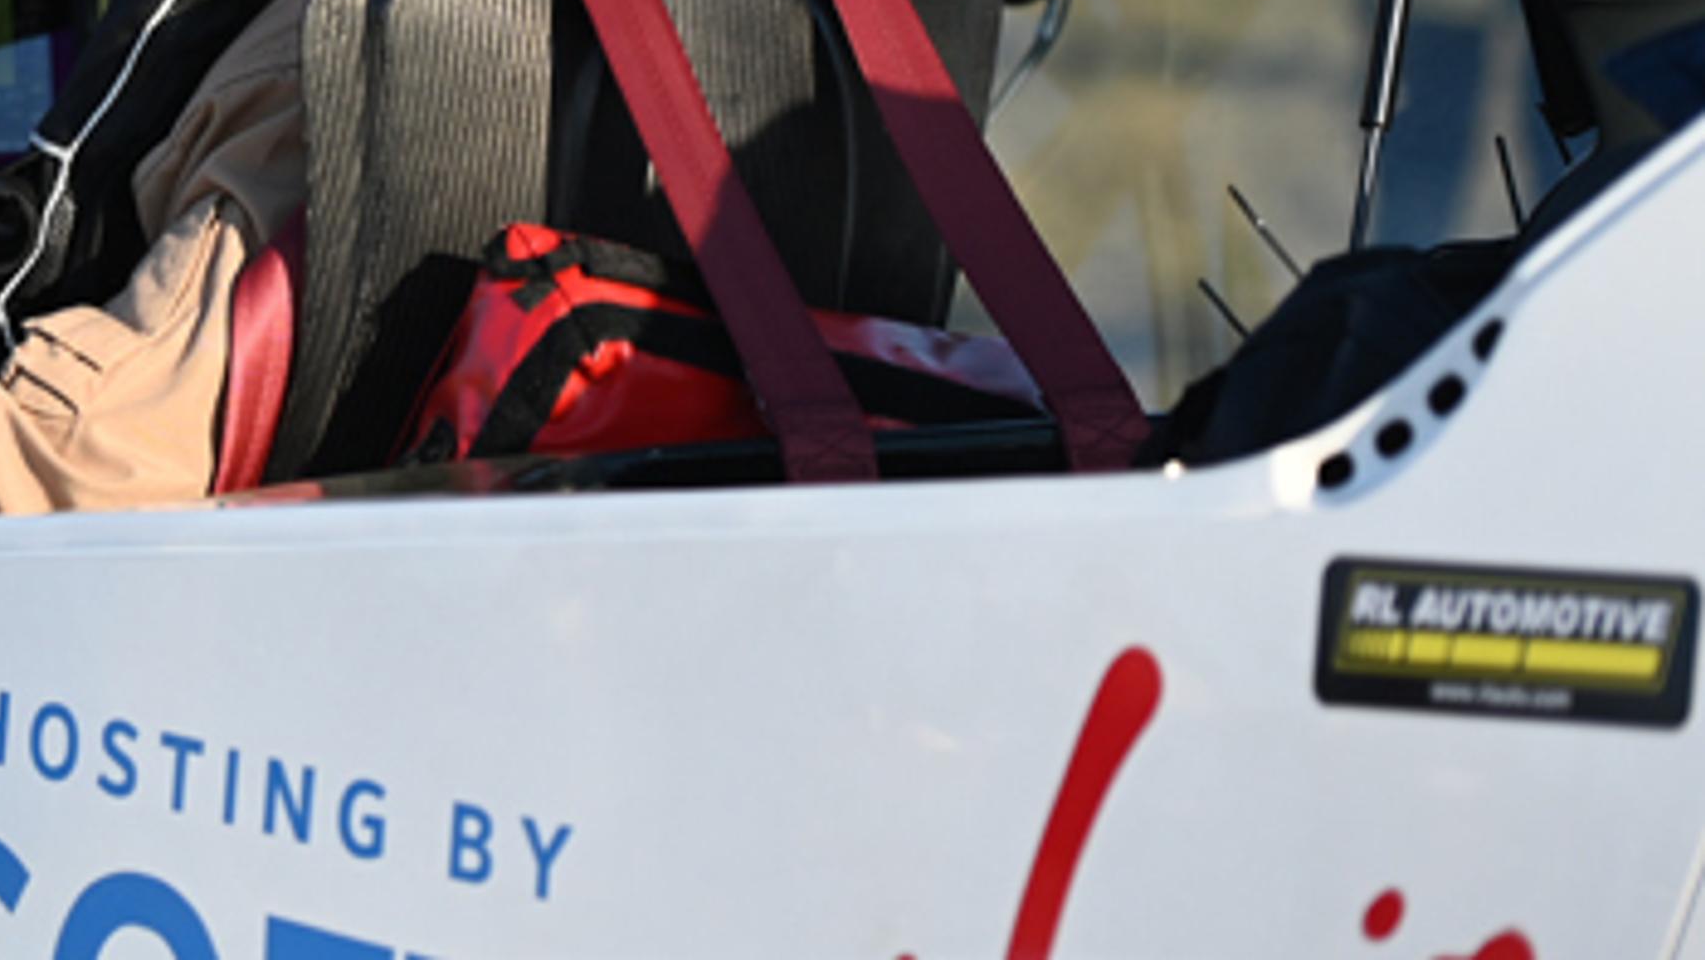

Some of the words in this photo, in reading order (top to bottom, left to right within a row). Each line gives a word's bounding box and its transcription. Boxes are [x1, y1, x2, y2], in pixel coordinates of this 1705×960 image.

[1351, 582, 1401, 625] RL
[1409, 587, 1672, 641] AUTOMOTIVE
[448, 801, 575, 902] BY
